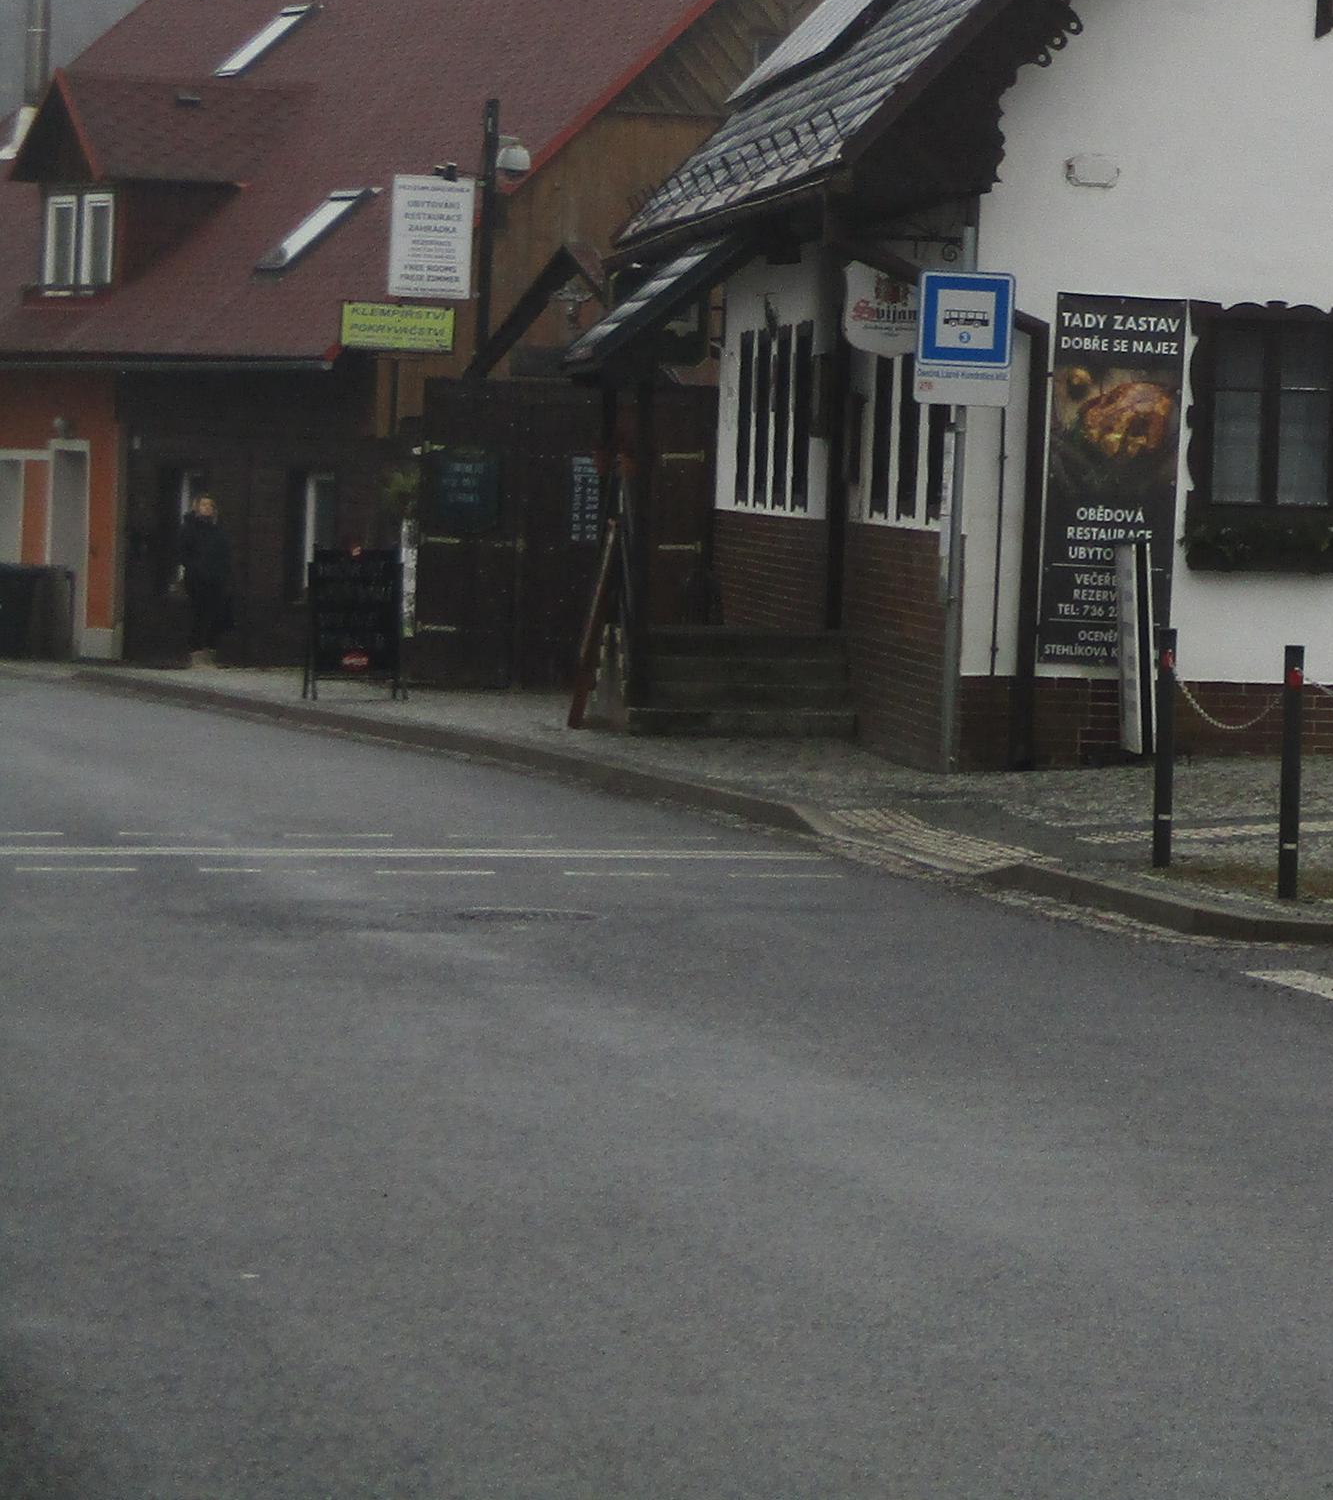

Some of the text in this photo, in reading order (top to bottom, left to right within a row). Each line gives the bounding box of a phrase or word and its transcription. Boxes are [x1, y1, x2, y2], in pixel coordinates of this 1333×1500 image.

[852, 300, 917, 323] Svijan
[1062, 312, 1180, 333] TADY ZASTAV
[1061, 335, 1178, 355] DOBŘE SE NAJEZ
[1076, 505, 1145, 524] OBĚDOVÁ
[1068, 546, 1115, 561] UBYTO
[1073, 588, 1120, 601] REZERV
[1057, 603, 1080, 616] TEL:
[1082, 604, 1105, 617] 736
[1045, 643, 1108, 657] STEHLÍKOVA
